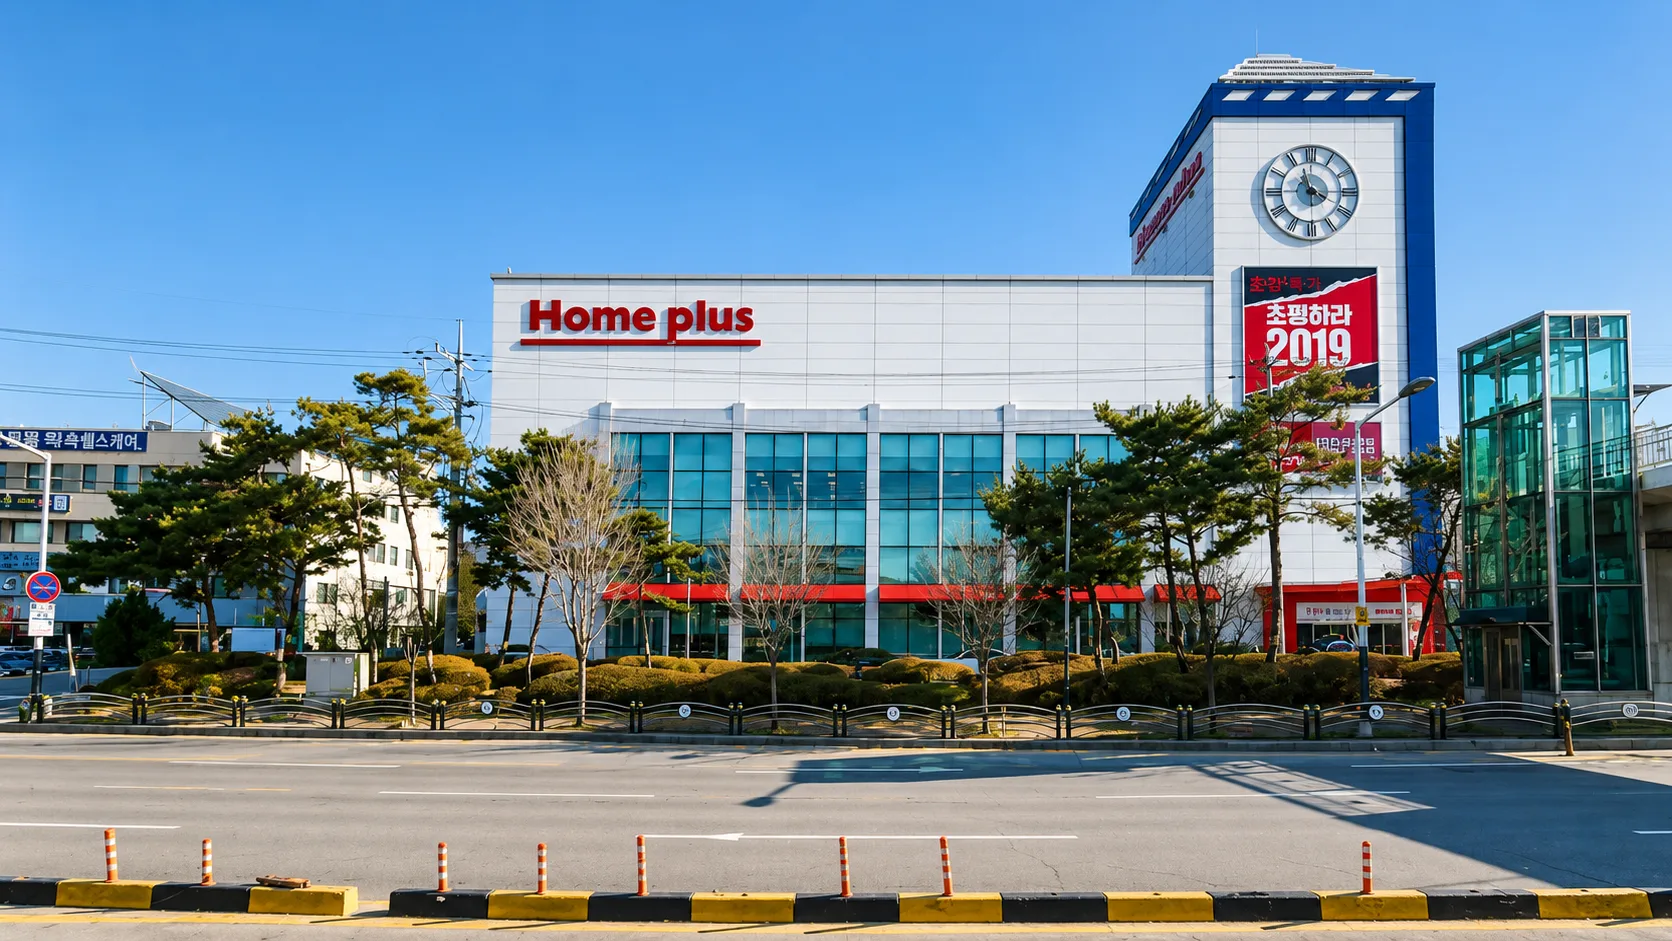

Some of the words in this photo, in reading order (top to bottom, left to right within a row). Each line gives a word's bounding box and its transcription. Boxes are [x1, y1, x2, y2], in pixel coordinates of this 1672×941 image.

[529, 299, 656, 332] Home
[667, 300, 754, 344] plus
[1266, 327, 1352, 367] 2019
